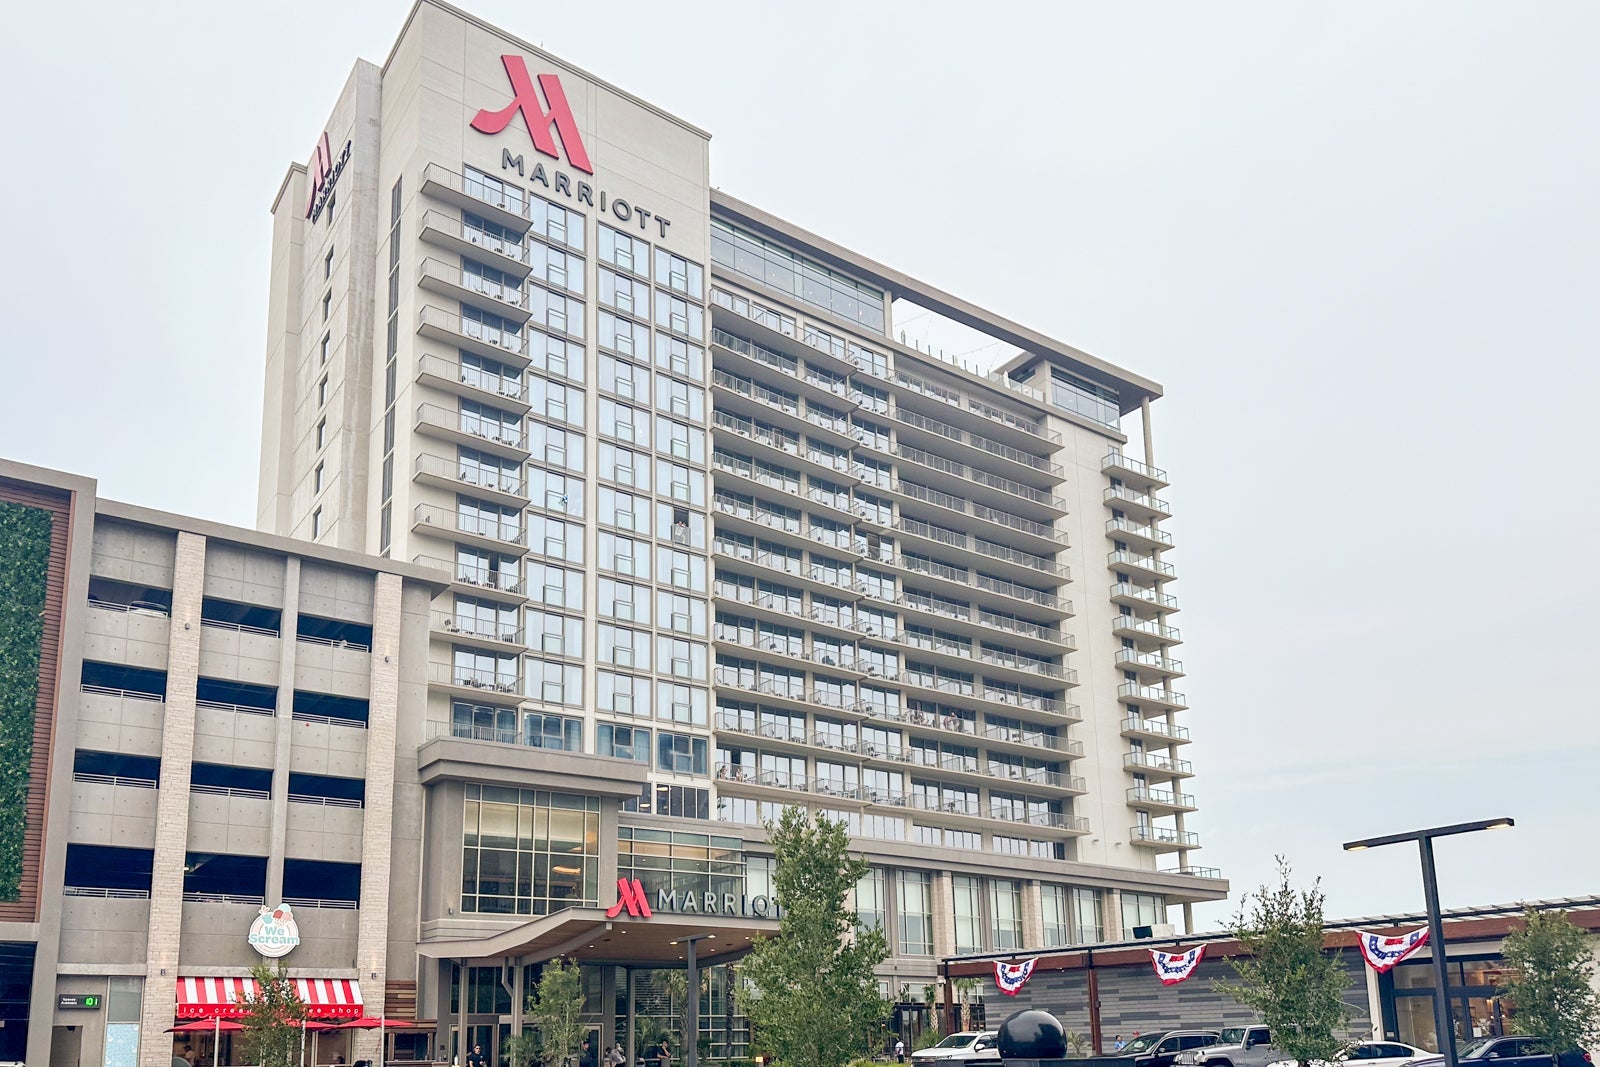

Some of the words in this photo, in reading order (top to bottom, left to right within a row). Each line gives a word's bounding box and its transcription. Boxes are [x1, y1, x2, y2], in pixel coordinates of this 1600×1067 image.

[501, 148, 670, 238] MARRIOTT
[264, 926, 285, 936] We
[249, 933, 299, 945] Scream
[331, 1007, 359, 1015] shop
